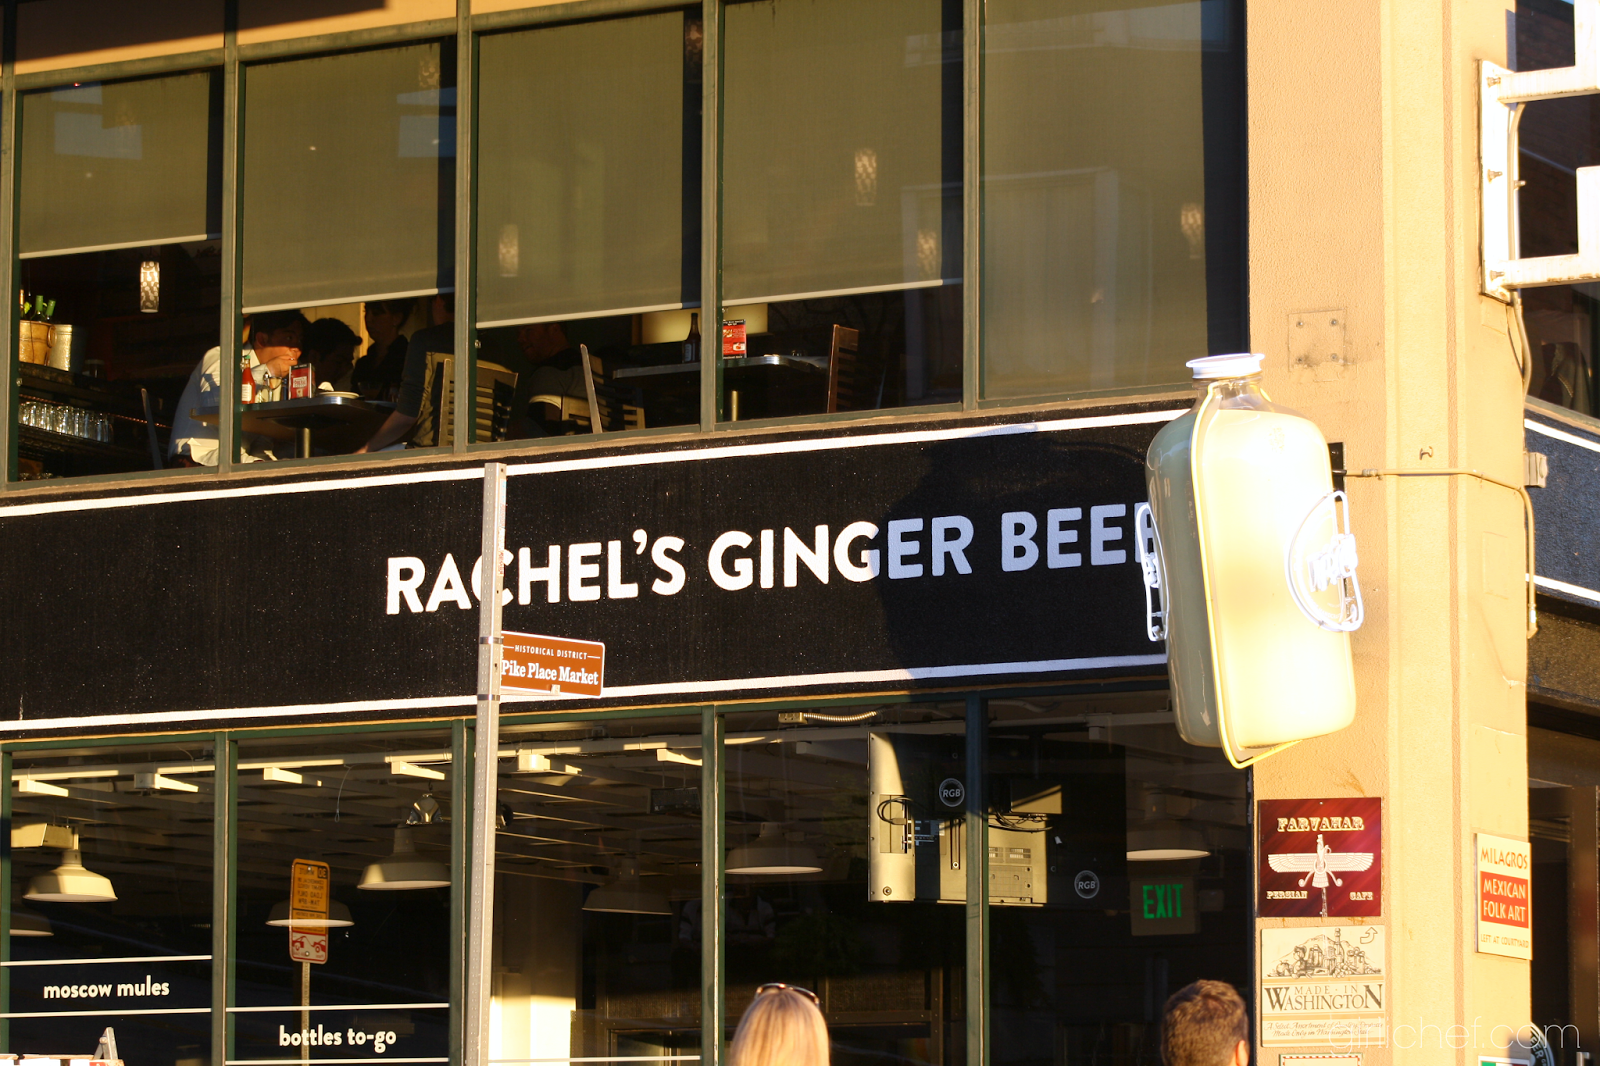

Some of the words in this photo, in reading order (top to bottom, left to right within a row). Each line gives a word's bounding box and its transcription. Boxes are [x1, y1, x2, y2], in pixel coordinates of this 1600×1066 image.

[386, 528, 686, 615] RACHEL'S
[707, 513, 974, 592] GINGER
[514, 644, 555, 657] HISTORICAL
[556, 649, 588, 660] DISTRICT
[501, 659, 527, 678] Pike
[527, 662, 558, 681] Place
[558, 665, 599, 686] Market
[942, 788, 961, 798] RGB
[1276, 815, 1365, 832] FARVAHAR
[1480, 846, 1528, 870] MILAGROS
[1078, 880, 1096, 890] RGB
[1265, 890, 1308, 900] PERSIAN
[1349, 891, 1374, 901] CAFE
[1483, 878, 1526, 899] MEXICAN
[1142, 883, 1184, 920] EXIT
[1483, 900, 1506, 919] FOLK
[1507, 904, 1526, 922] ART
[1480, 933, 1492, 943] LEFT
[1493, 935, 1500, 945] AT
[1500, 936, 1529, 949] COURTYARD
[43, 982, 113, 999] moscow
[117, 974, 170, 997] mules
[1294, 985, 1331, 995] MADE
[1344, 984, 1358, 994] IN
[1264, 984, 1383, 1011] WASHINGTON
[279, 1023, 343, 1047] bottles
[347, 1027, 397, 1054] to-go
